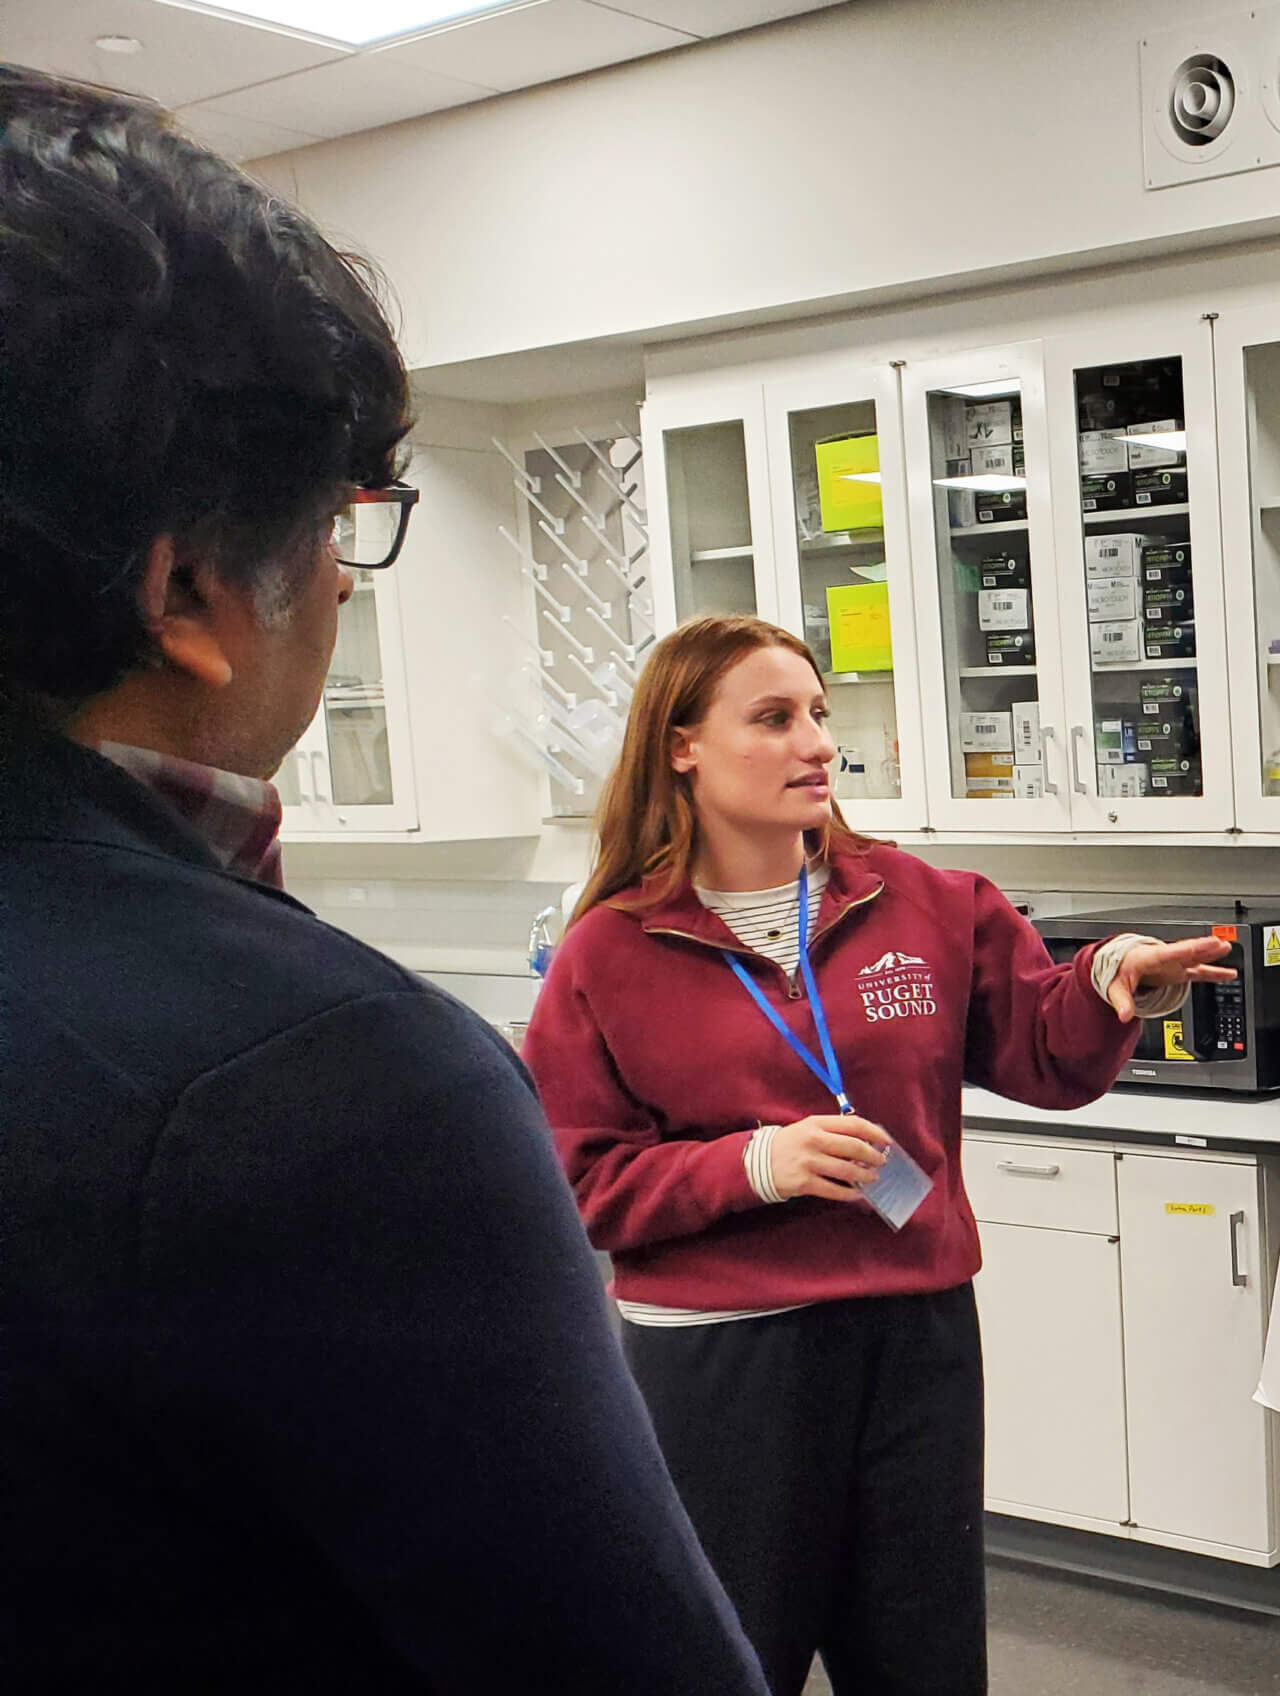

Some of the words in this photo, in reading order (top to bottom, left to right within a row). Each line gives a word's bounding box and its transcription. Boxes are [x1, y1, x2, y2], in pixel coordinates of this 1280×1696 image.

[858, 974, 922, 990] UNIVERSITY
[861, 984, 933, 1006] PUGET
[866, 1000, 936, 1022] SOUND
